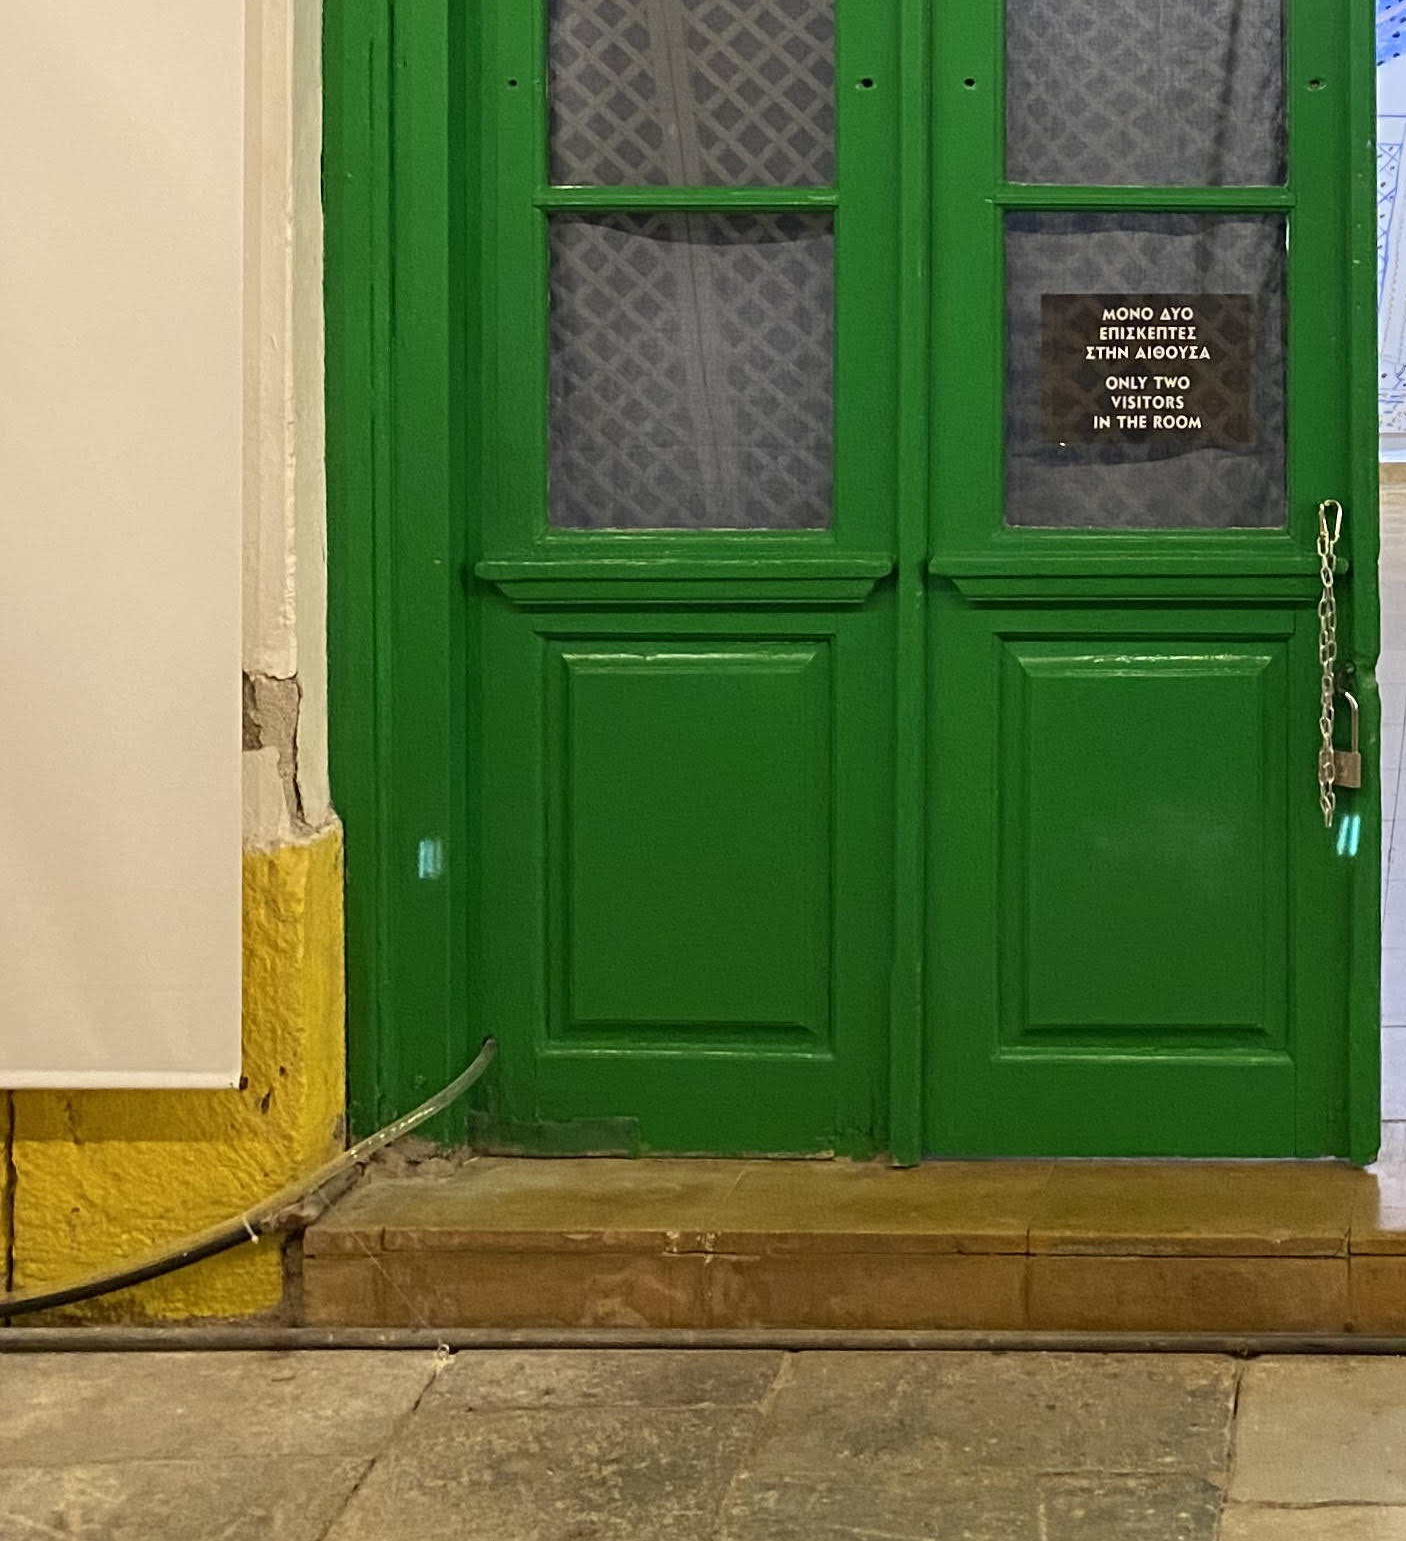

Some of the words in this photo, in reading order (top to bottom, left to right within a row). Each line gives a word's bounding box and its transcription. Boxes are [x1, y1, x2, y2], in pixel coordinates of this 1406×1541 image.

[1103, 307, 1153, 320] ΜΟΝΟ
[1160, 307, 1193, 320] ΔΥΟ
[1100, 327, 1196, 340] ΕΠΙΣΚΕΠΤΕΣ
[1086, 346, 1128, 359] ΣΤΗΝ
[1135, 346, 1210, 359] ΑΙΘΟΥΣΑ
[1106, 376, 1147, 390] ONLY
[1154, 376, 1190, 389] TWO
[1111, 396, 1184, 409] VISITORS
[1094, 416, 1110, 428] IN
[1117, 416, 1146, 428] THE
[1154, 415, 1201, 428] ROOM
